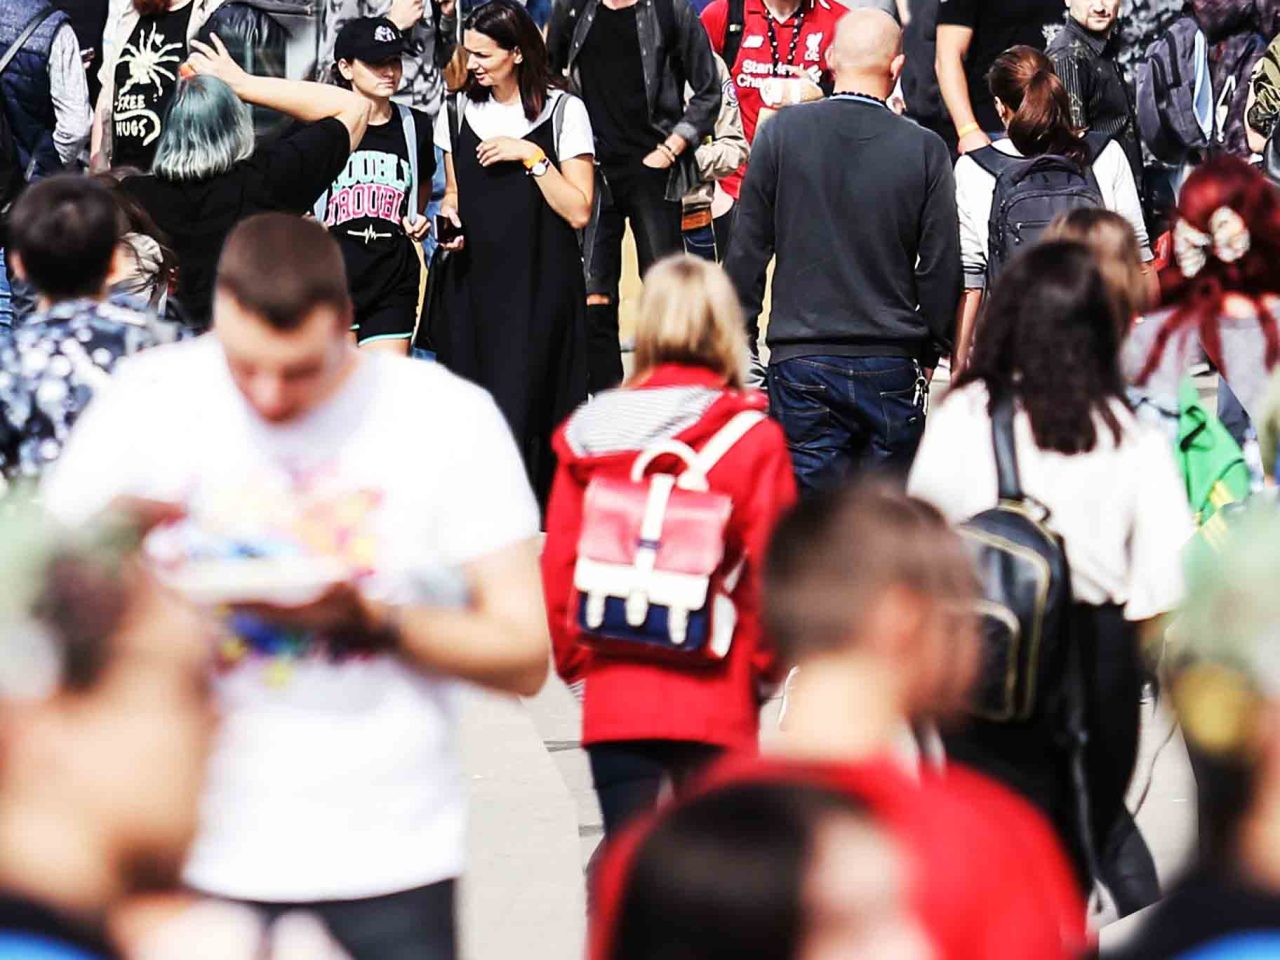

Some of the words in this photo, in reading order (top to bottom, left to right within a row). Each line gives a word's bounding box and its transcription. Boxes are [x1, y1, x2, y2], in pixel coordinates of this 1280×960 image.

[117, 94, 146, 111] FREE
[116, 118, 148, 138] HUGS
[325, 183, 404, 227] TROUBL
